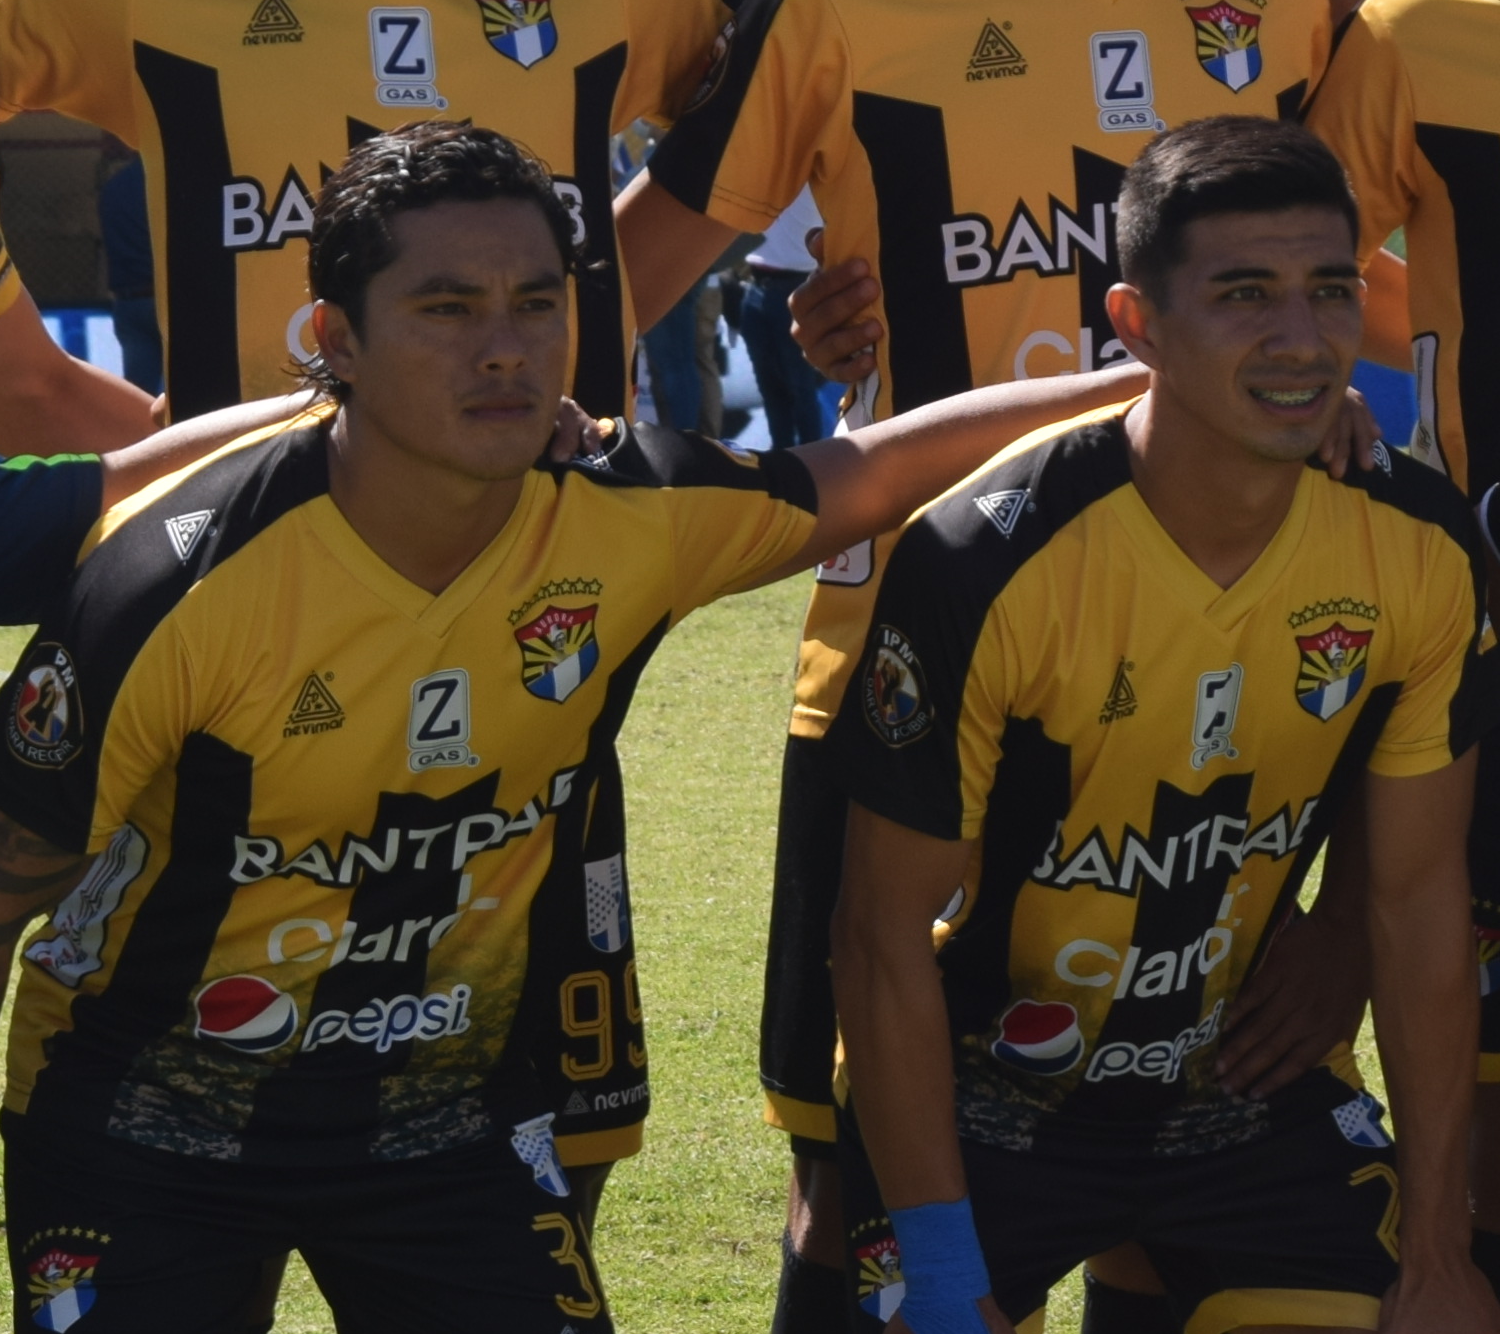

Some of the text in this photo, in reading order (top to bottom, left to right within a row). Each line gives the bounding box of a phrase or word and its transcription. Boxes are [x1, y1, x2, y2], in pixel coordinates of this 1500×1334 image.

[242, 31, 305, 46] nevimar
[379, 16, 426, 75] Z
[965, 63, 1029, 83] nevimar
[1099, 40, 1145, 101] Z
[385, 87, 428, 101] GAS
[1107, 111, 1148, 126] GAS
[1014, 328, 1134, 381] Cla
[883, 629, 915, 665] IPM
[417, 678, 460, 741] Z
[283, 717, 347, 739] nevimar
[418, 749, 461, 766] GAS
[1054, 926, 1233, 1001] Claro
[301, 983, 471, 1053] pepsi
[1085, 997, 1226, 1084] pepsi
[594, 1084, 649, 1111] nevim
